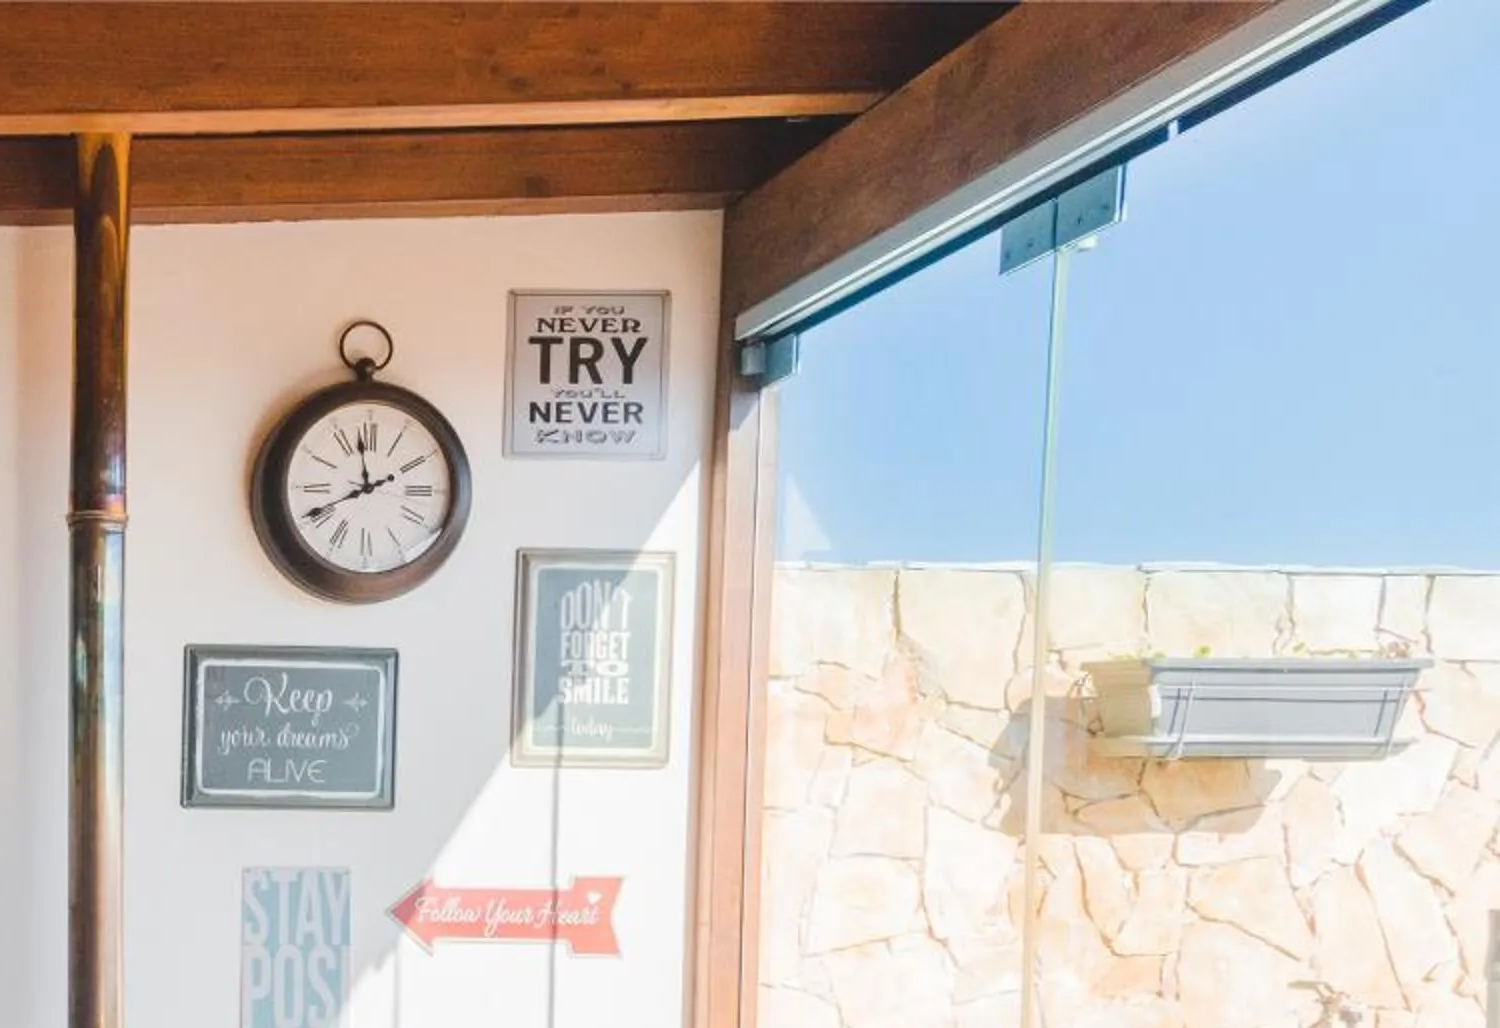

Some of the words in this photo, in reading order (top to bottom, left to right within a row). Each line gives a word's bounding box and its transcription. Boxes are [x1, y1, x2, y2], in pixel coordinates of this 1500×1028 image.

[555, 304, 574, 315] IF
[580, 304, 626, 315] YOU
[537, 317, 642, 333] NEVER
[528, 336, 649, 385] TRY
[529, 402, 644, 424] NEVER
[537, 429, 637, 444] KNOW
[560, 630, 632, 661] FORGET
[243, 671, 334, 727] Keep
[558, 677, 630, 705] SMILE
[217, 725, 267, 756] your
[277, 722, 359, 750] dreams
[248, 758, 328, 783] ALIVE
[243, 867, 350, 946] STAY
[414, 896, 482, 924] Follow
[484, 897, 534, 938] Your
[534, 899, 601, 929] Heart
